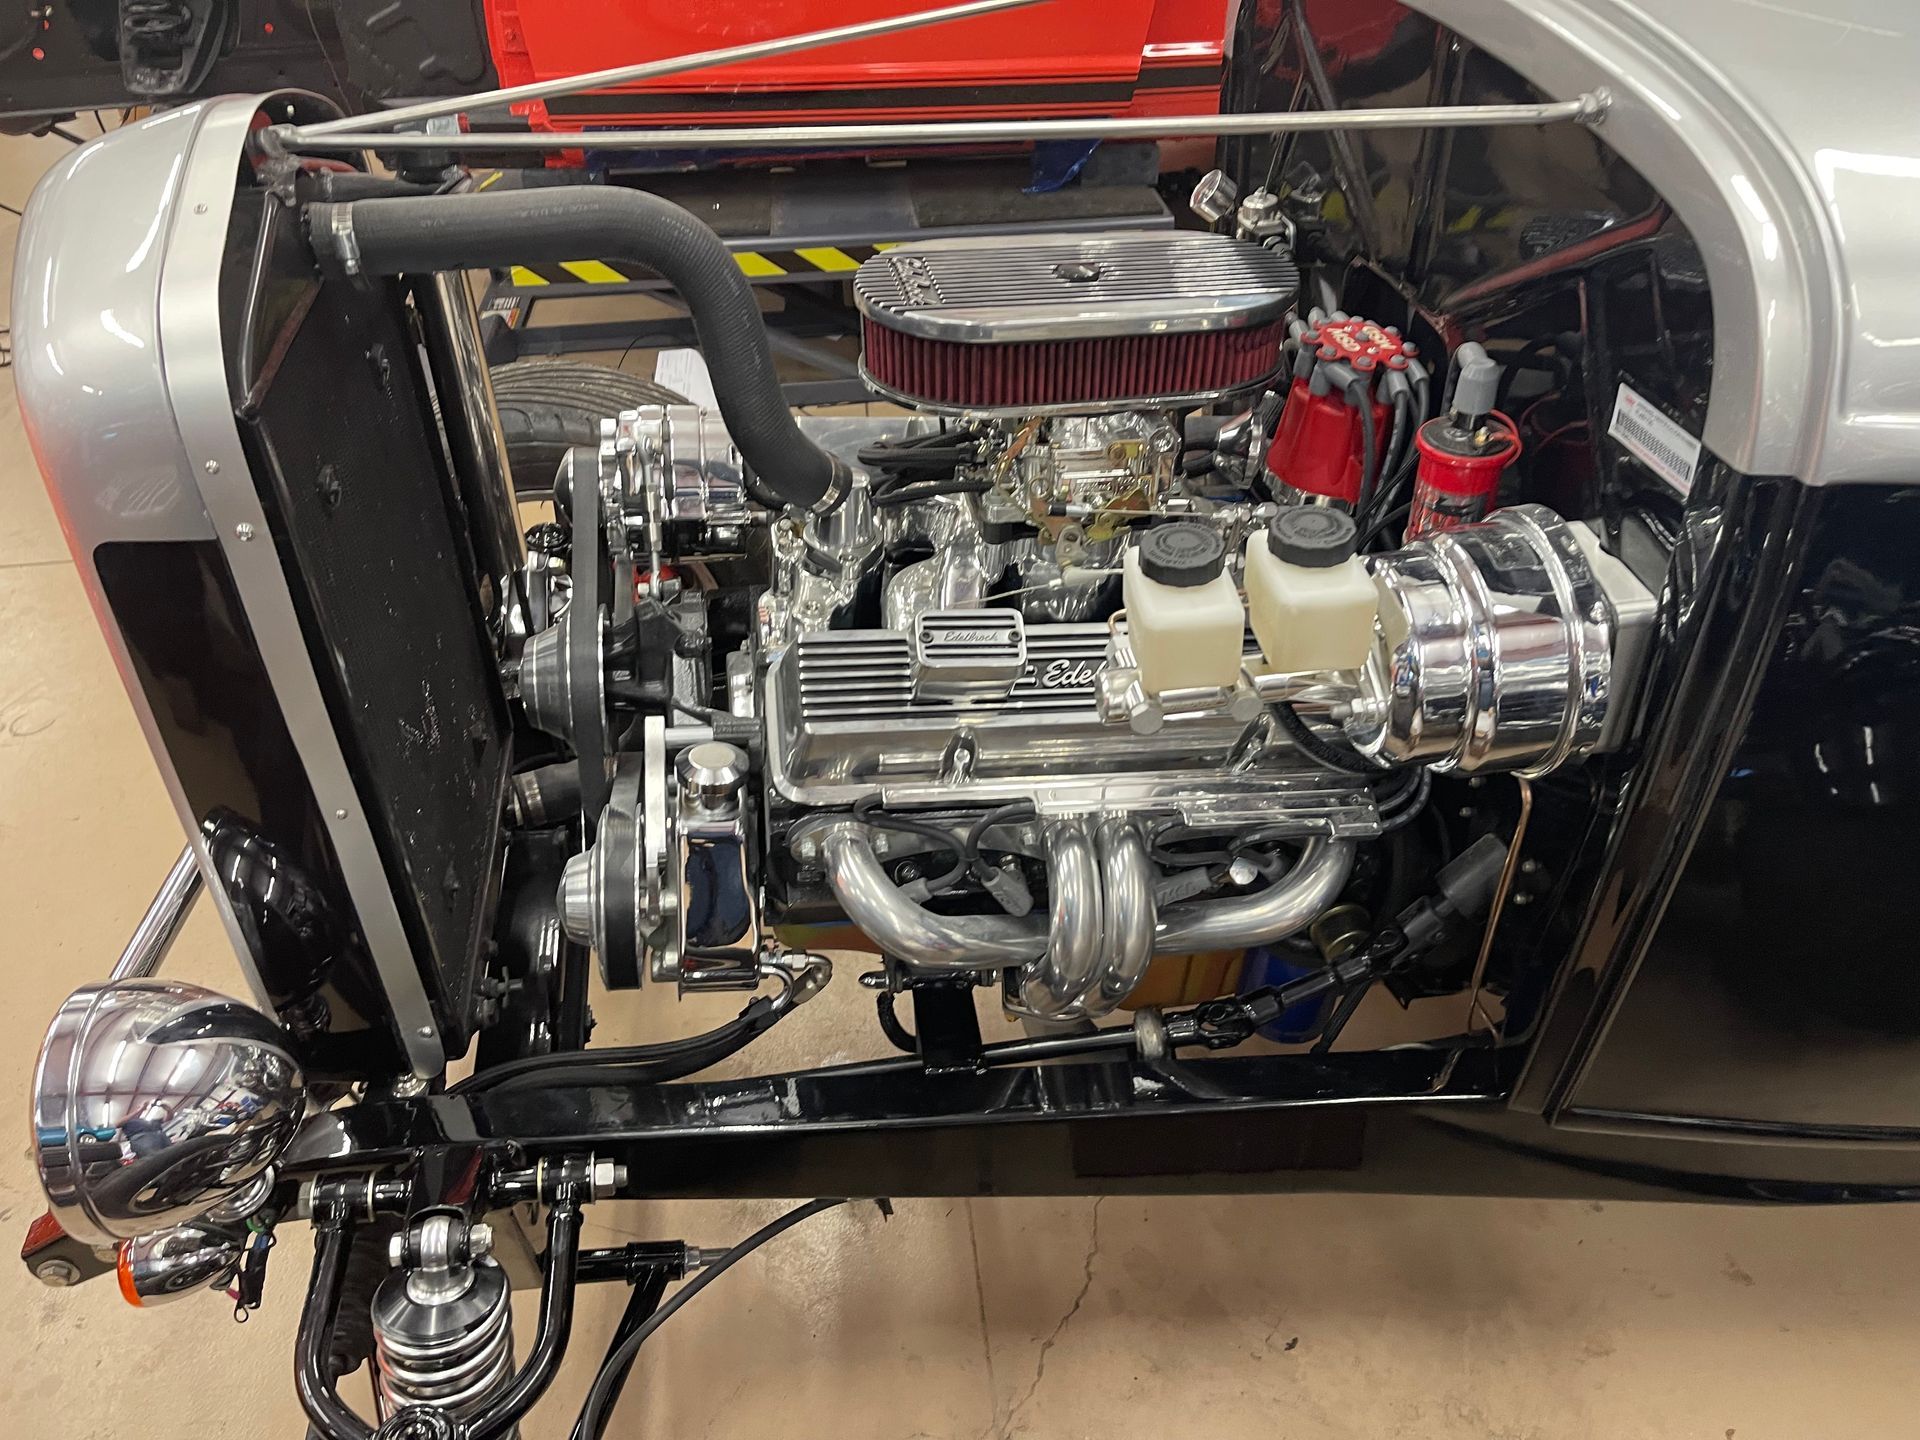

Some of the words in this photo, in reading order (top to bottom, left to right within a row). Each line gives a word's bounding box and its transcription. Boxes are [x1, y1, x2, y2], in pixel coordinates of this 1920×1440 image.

[1326, 327, 1361, 352] MSD
[1362, 326, 1397, 350] MSD
[943, 631, 999, 643] Edelbrock
